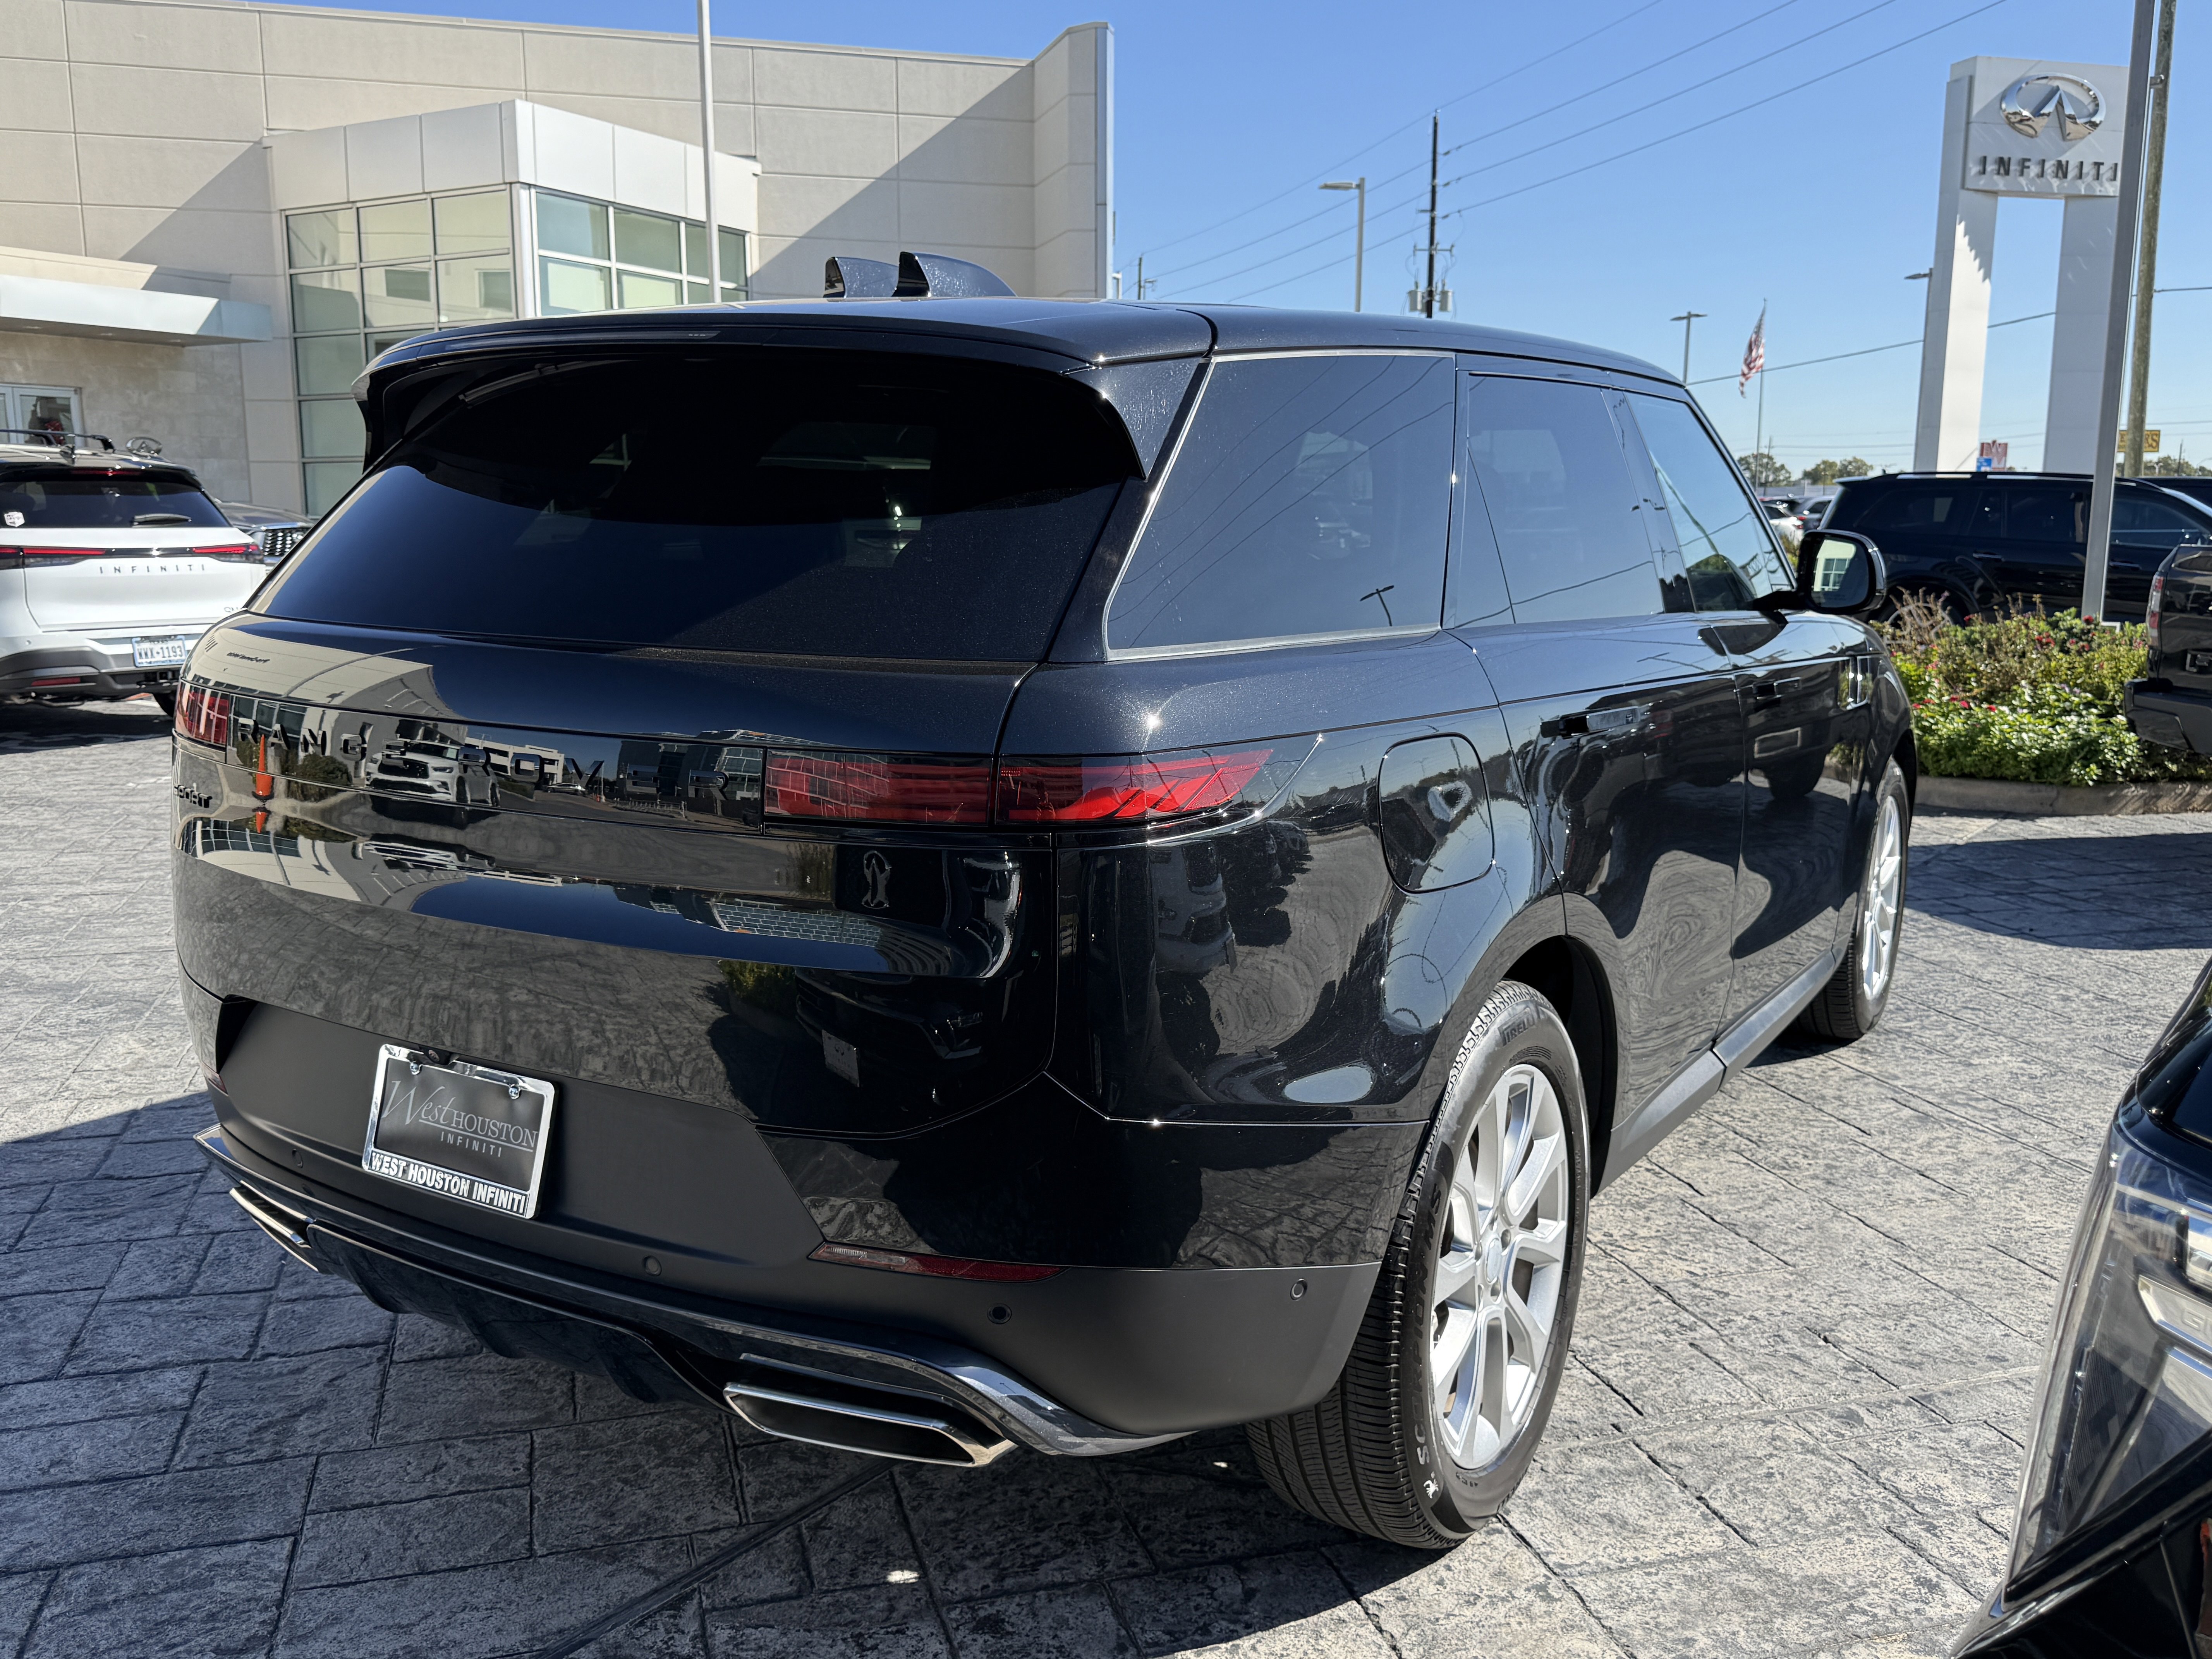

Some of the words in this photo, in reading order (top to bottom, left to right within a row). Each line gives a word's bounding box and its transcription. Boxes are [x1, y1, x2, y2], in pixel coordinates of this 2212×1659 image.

[1979, 155, 2118, 181] INFINITI
[100, 564, 205, 574] INFINITI
[237, 718, 407, 762] RANGE
[458, 747, 730, 800] ROVER
[174, 784, 213, 808] SPORT
[381, 1081, 456, 1125] West
[452, 1111, 538, 1148] HOUSTON
[441, 1131, 502, 1158] INFINITI
[371, 1152, 406, 1177] WEST
[408, 1162, 471, 1197] HOUSTON
[472, 1182, 526, 1214] INFINITI
